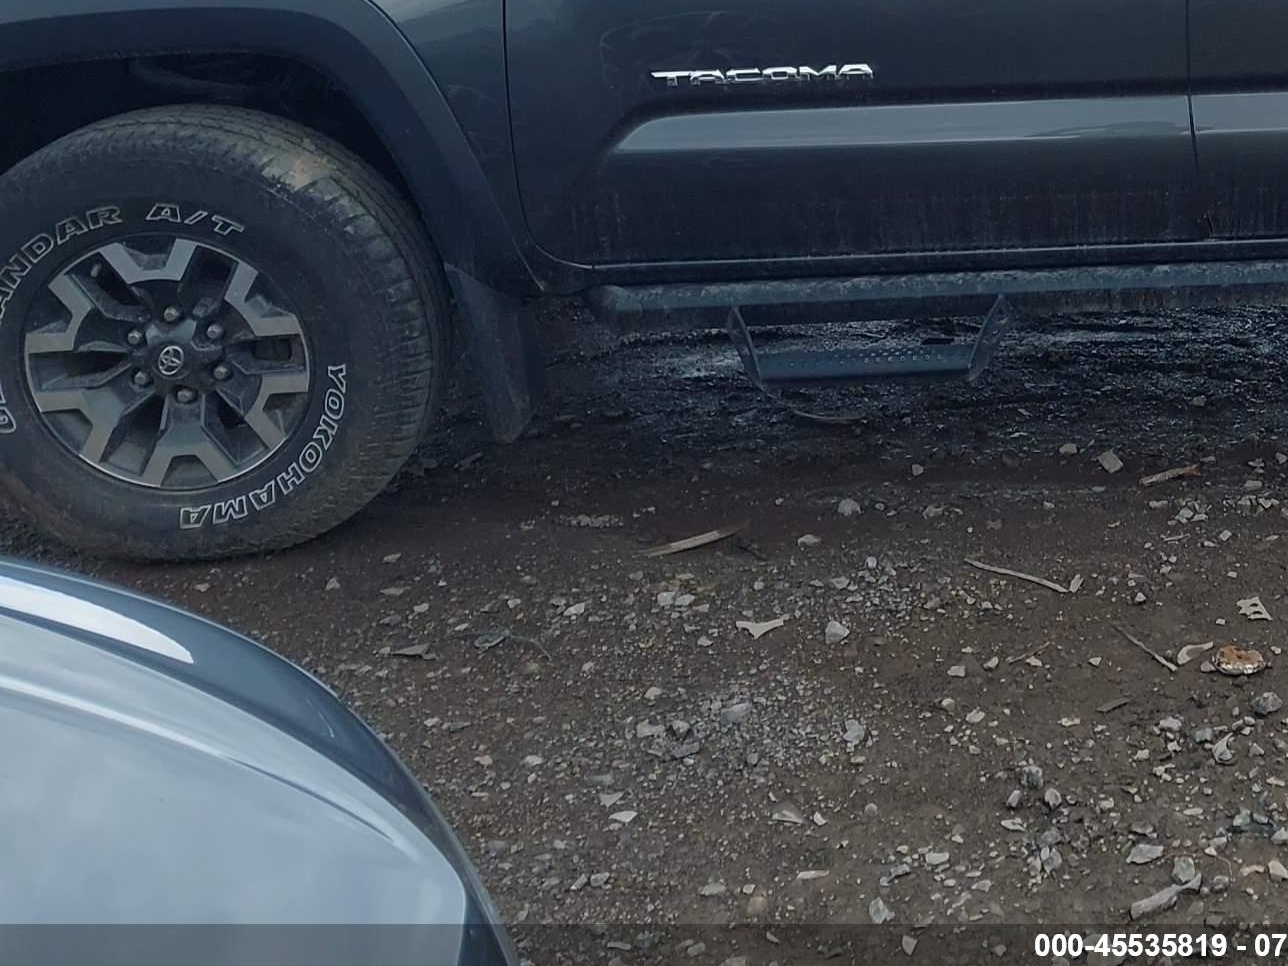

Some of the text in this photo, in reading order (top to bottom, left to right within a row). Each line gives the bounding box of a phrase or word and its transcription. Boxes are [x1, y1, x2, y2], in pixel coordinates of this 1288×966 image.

[651, 64, 873, 87] TACOMA
[145, 203, 245, 235] A/T
[180, 364, 347, 529] YOKOHAMA
